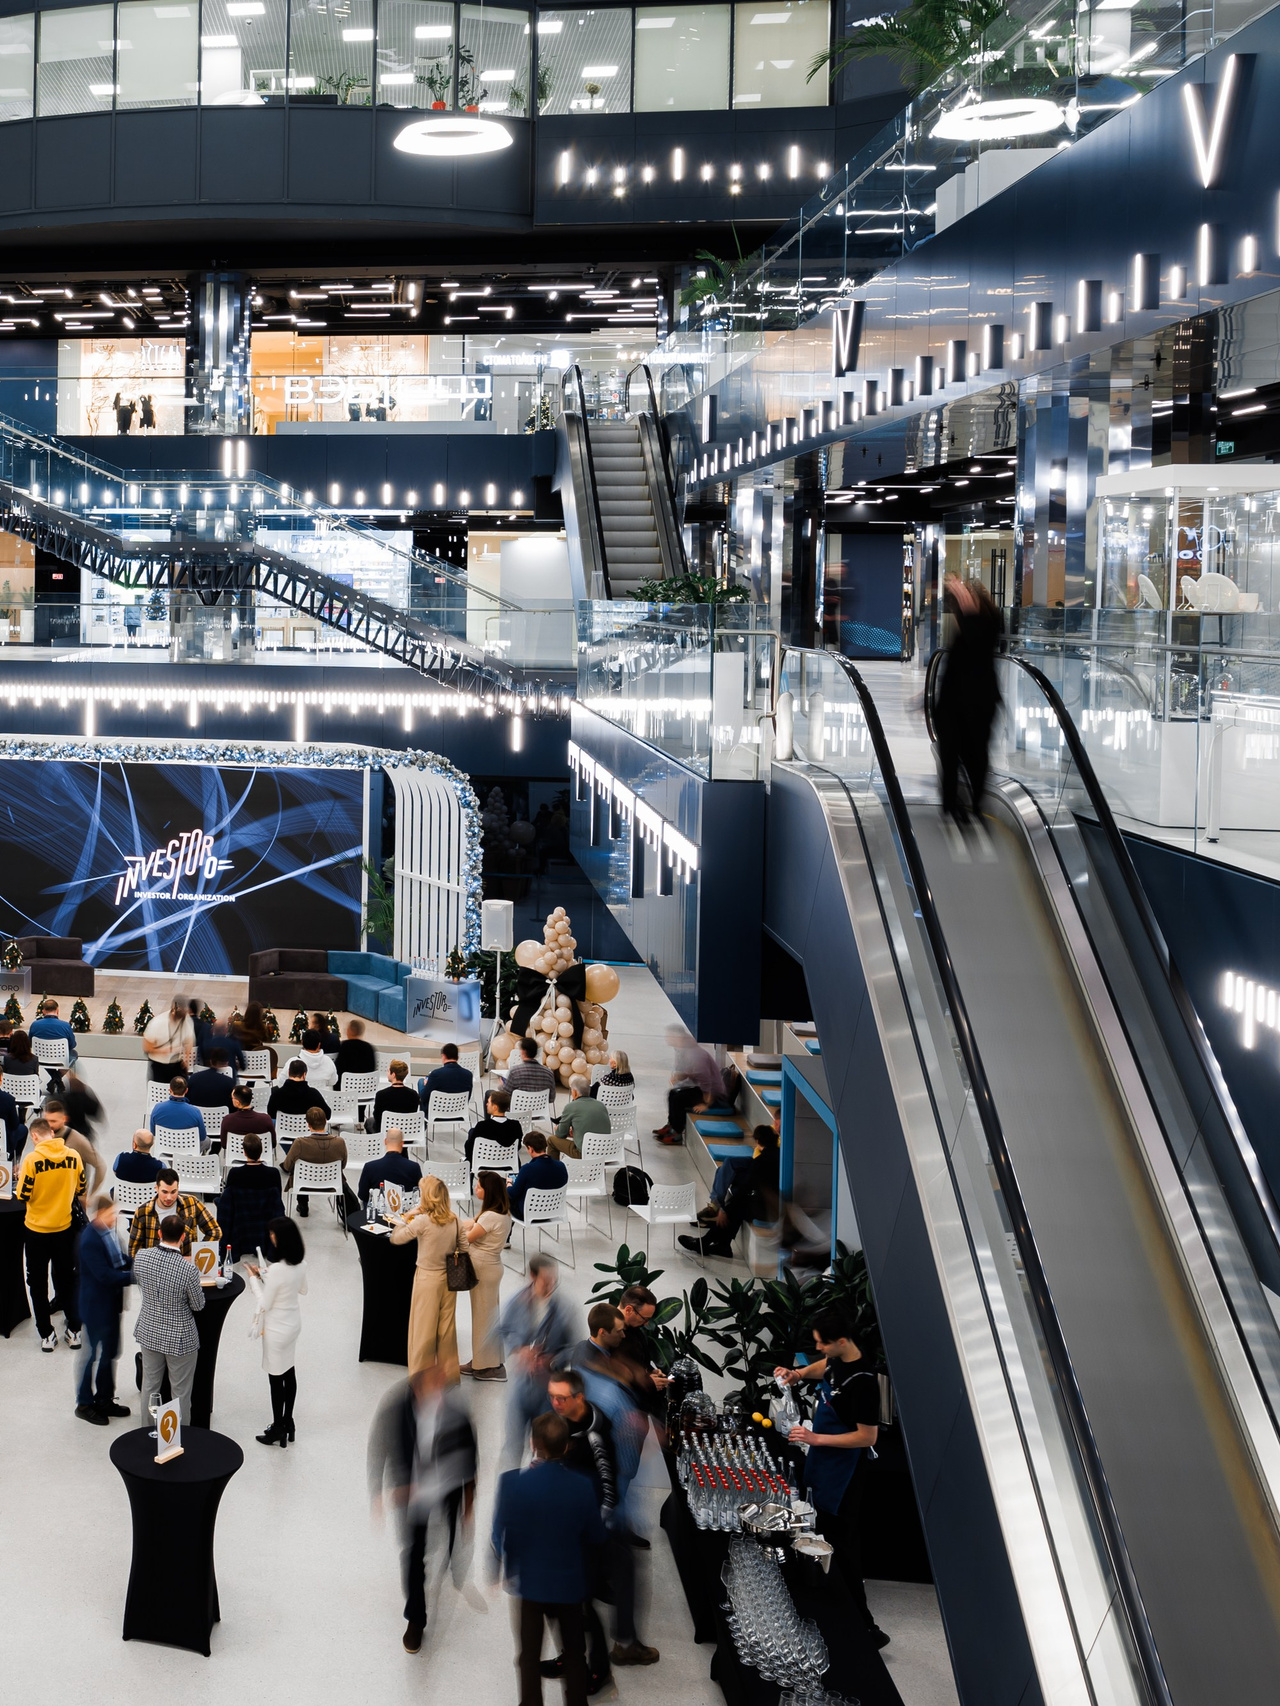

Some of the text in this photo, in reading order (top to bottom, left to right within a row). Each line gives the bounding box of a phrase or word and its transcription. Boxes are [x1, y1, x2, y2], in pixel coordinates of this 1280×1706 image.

[134, 891, 236, 903] INVESTOR ORGANIZATION
[389, 1188, 399, 1207] 8
[198, 1252, 212, 1275] 7
[163, 1415, 175, 1444] 3
